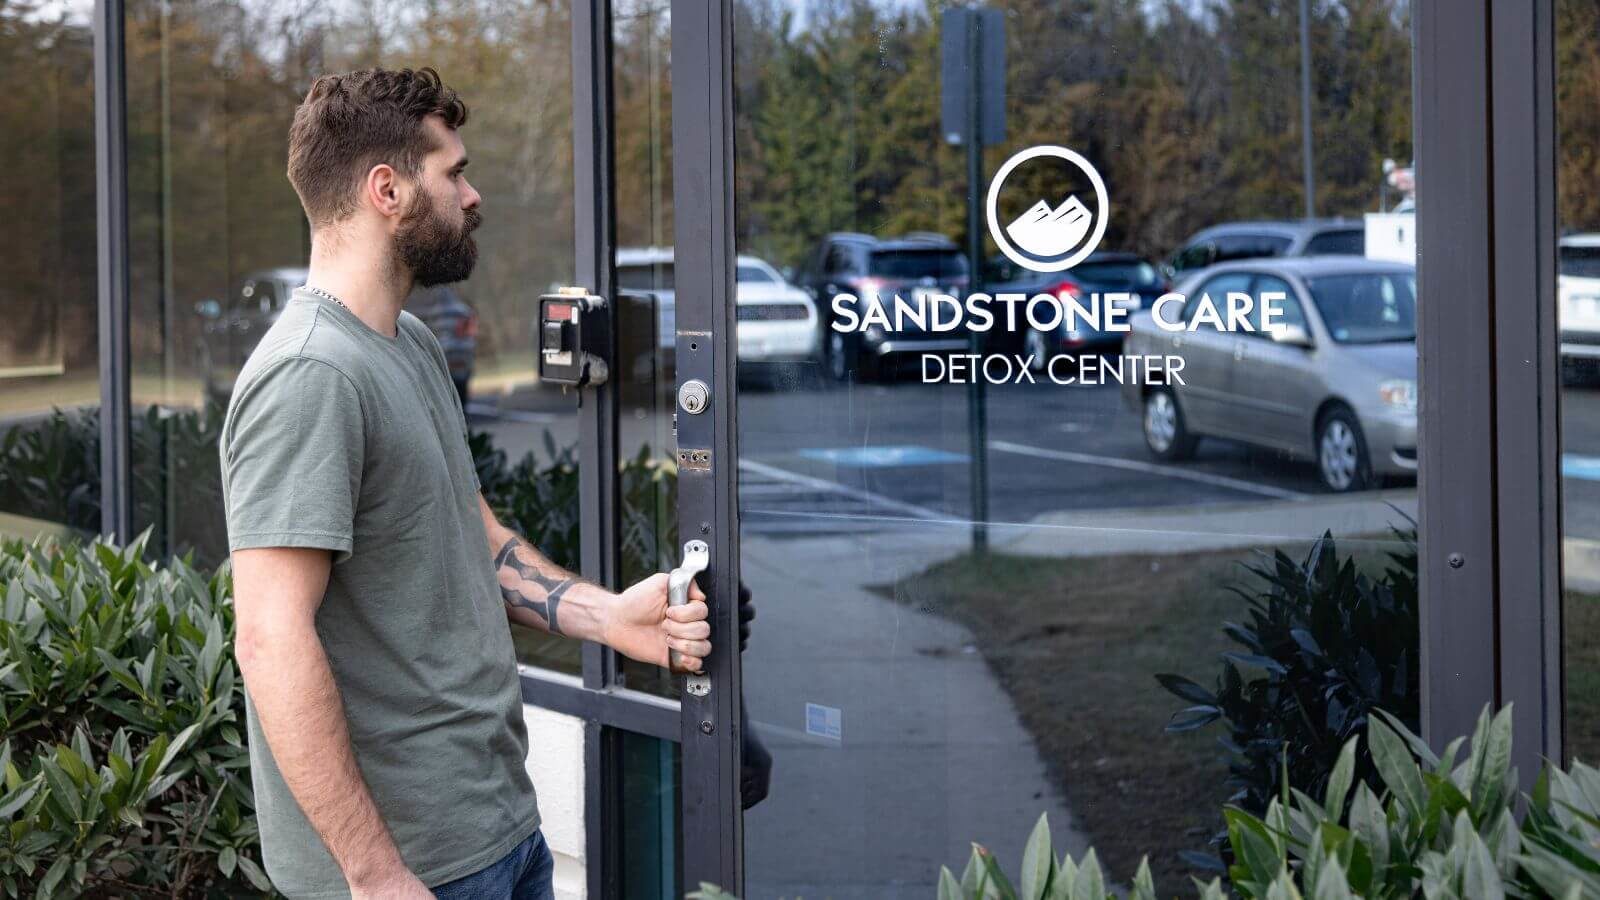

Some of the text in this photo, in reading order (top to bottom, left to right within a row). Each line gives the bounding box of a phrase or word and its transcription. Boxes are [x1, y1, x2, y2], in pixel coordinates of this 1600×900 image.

[831, 292, 1288, 333] SANDSTONE CARE
[921, 354, 1187, 386] DETOX CENTER
